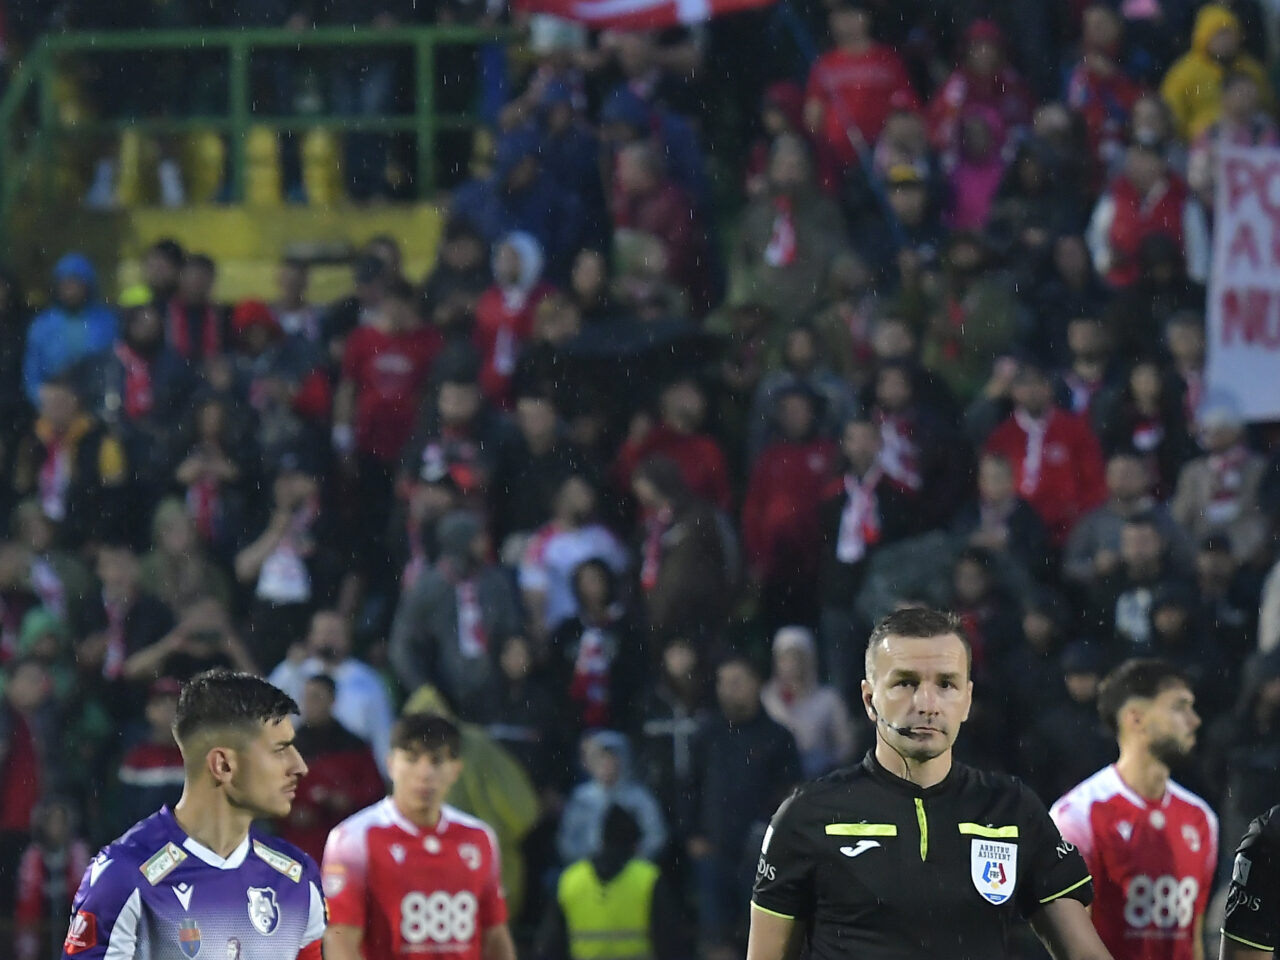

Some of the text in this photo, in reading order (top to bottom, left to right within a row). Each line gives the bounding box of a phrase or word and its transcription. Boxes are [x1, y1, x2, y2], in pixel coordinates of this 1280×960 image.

[978, 851, 1011, 861] ASISTENT
[980, 844, 1010, 853] ARBITRU
[401, 890, 478, 944] 888
[1124, 874, 1199, 929] 888
